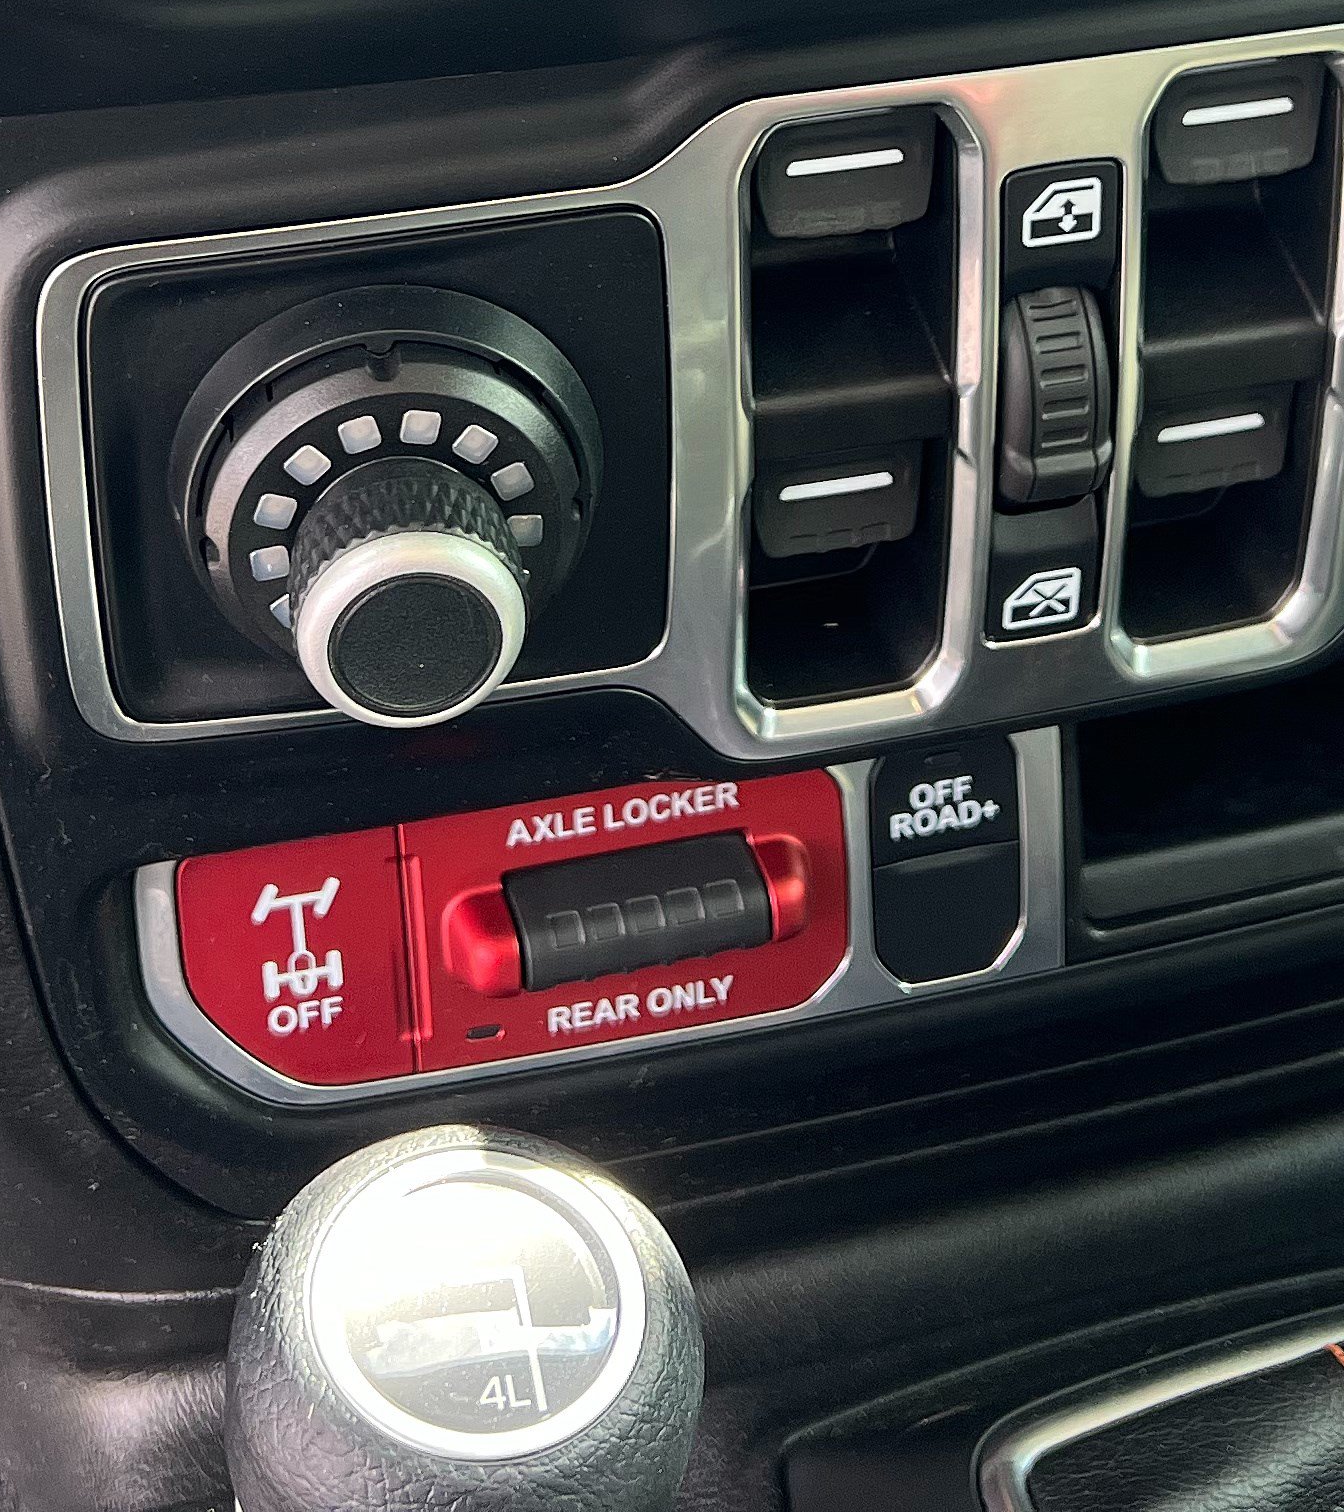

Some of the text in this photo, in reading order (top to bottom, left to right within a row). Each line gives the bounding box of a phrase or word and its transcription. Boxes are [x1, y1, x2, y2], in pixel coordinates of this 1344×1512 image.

[909, 774, 975, 809] OFF
[504, 782, 741, 848] AXLE LOCKER
[889, 799, 1001, 842] ROAD+
[267, 993, 344, 1037] OFF
[546, 974, 736, 1034] REAR ONLY
[479, 1374, 533, 1412] 4L
